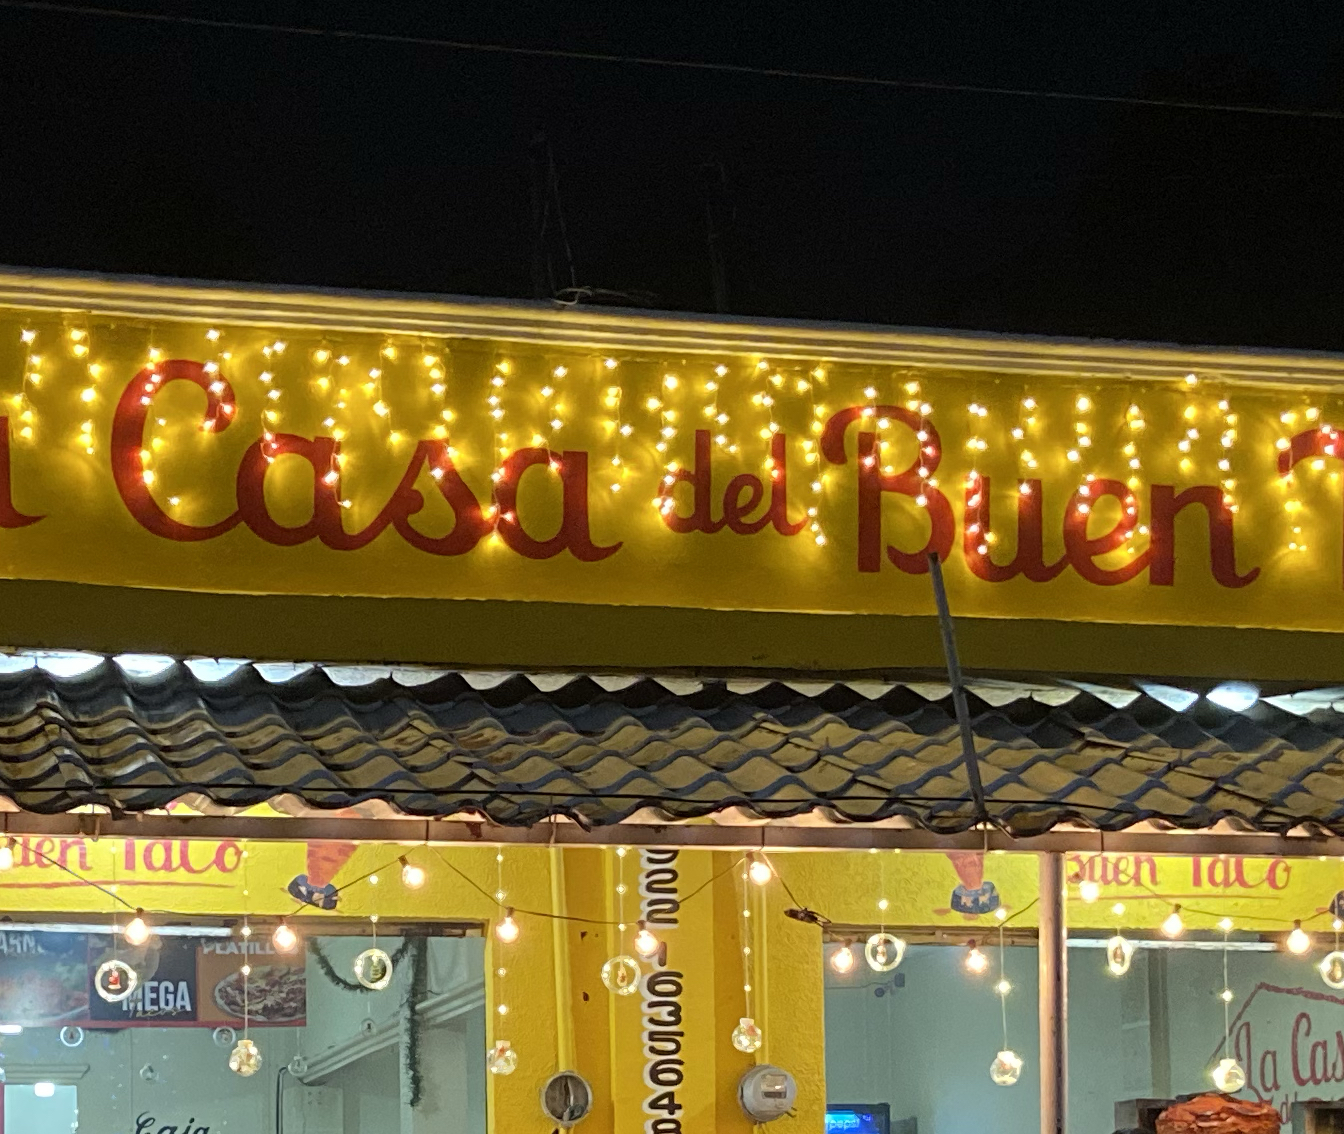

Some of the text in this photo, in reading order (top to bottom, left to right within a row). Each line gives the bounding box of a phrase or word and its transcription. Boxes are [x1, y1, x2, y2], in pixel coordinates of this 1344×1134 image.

[110, 358, 624, 560] Casa
[658, 424, 809, 539] del
[822, 402, 1260, 590] Buen
[122, 980, 192, 1012] MEGA
[1234, 1020, 1280, 1105] La
